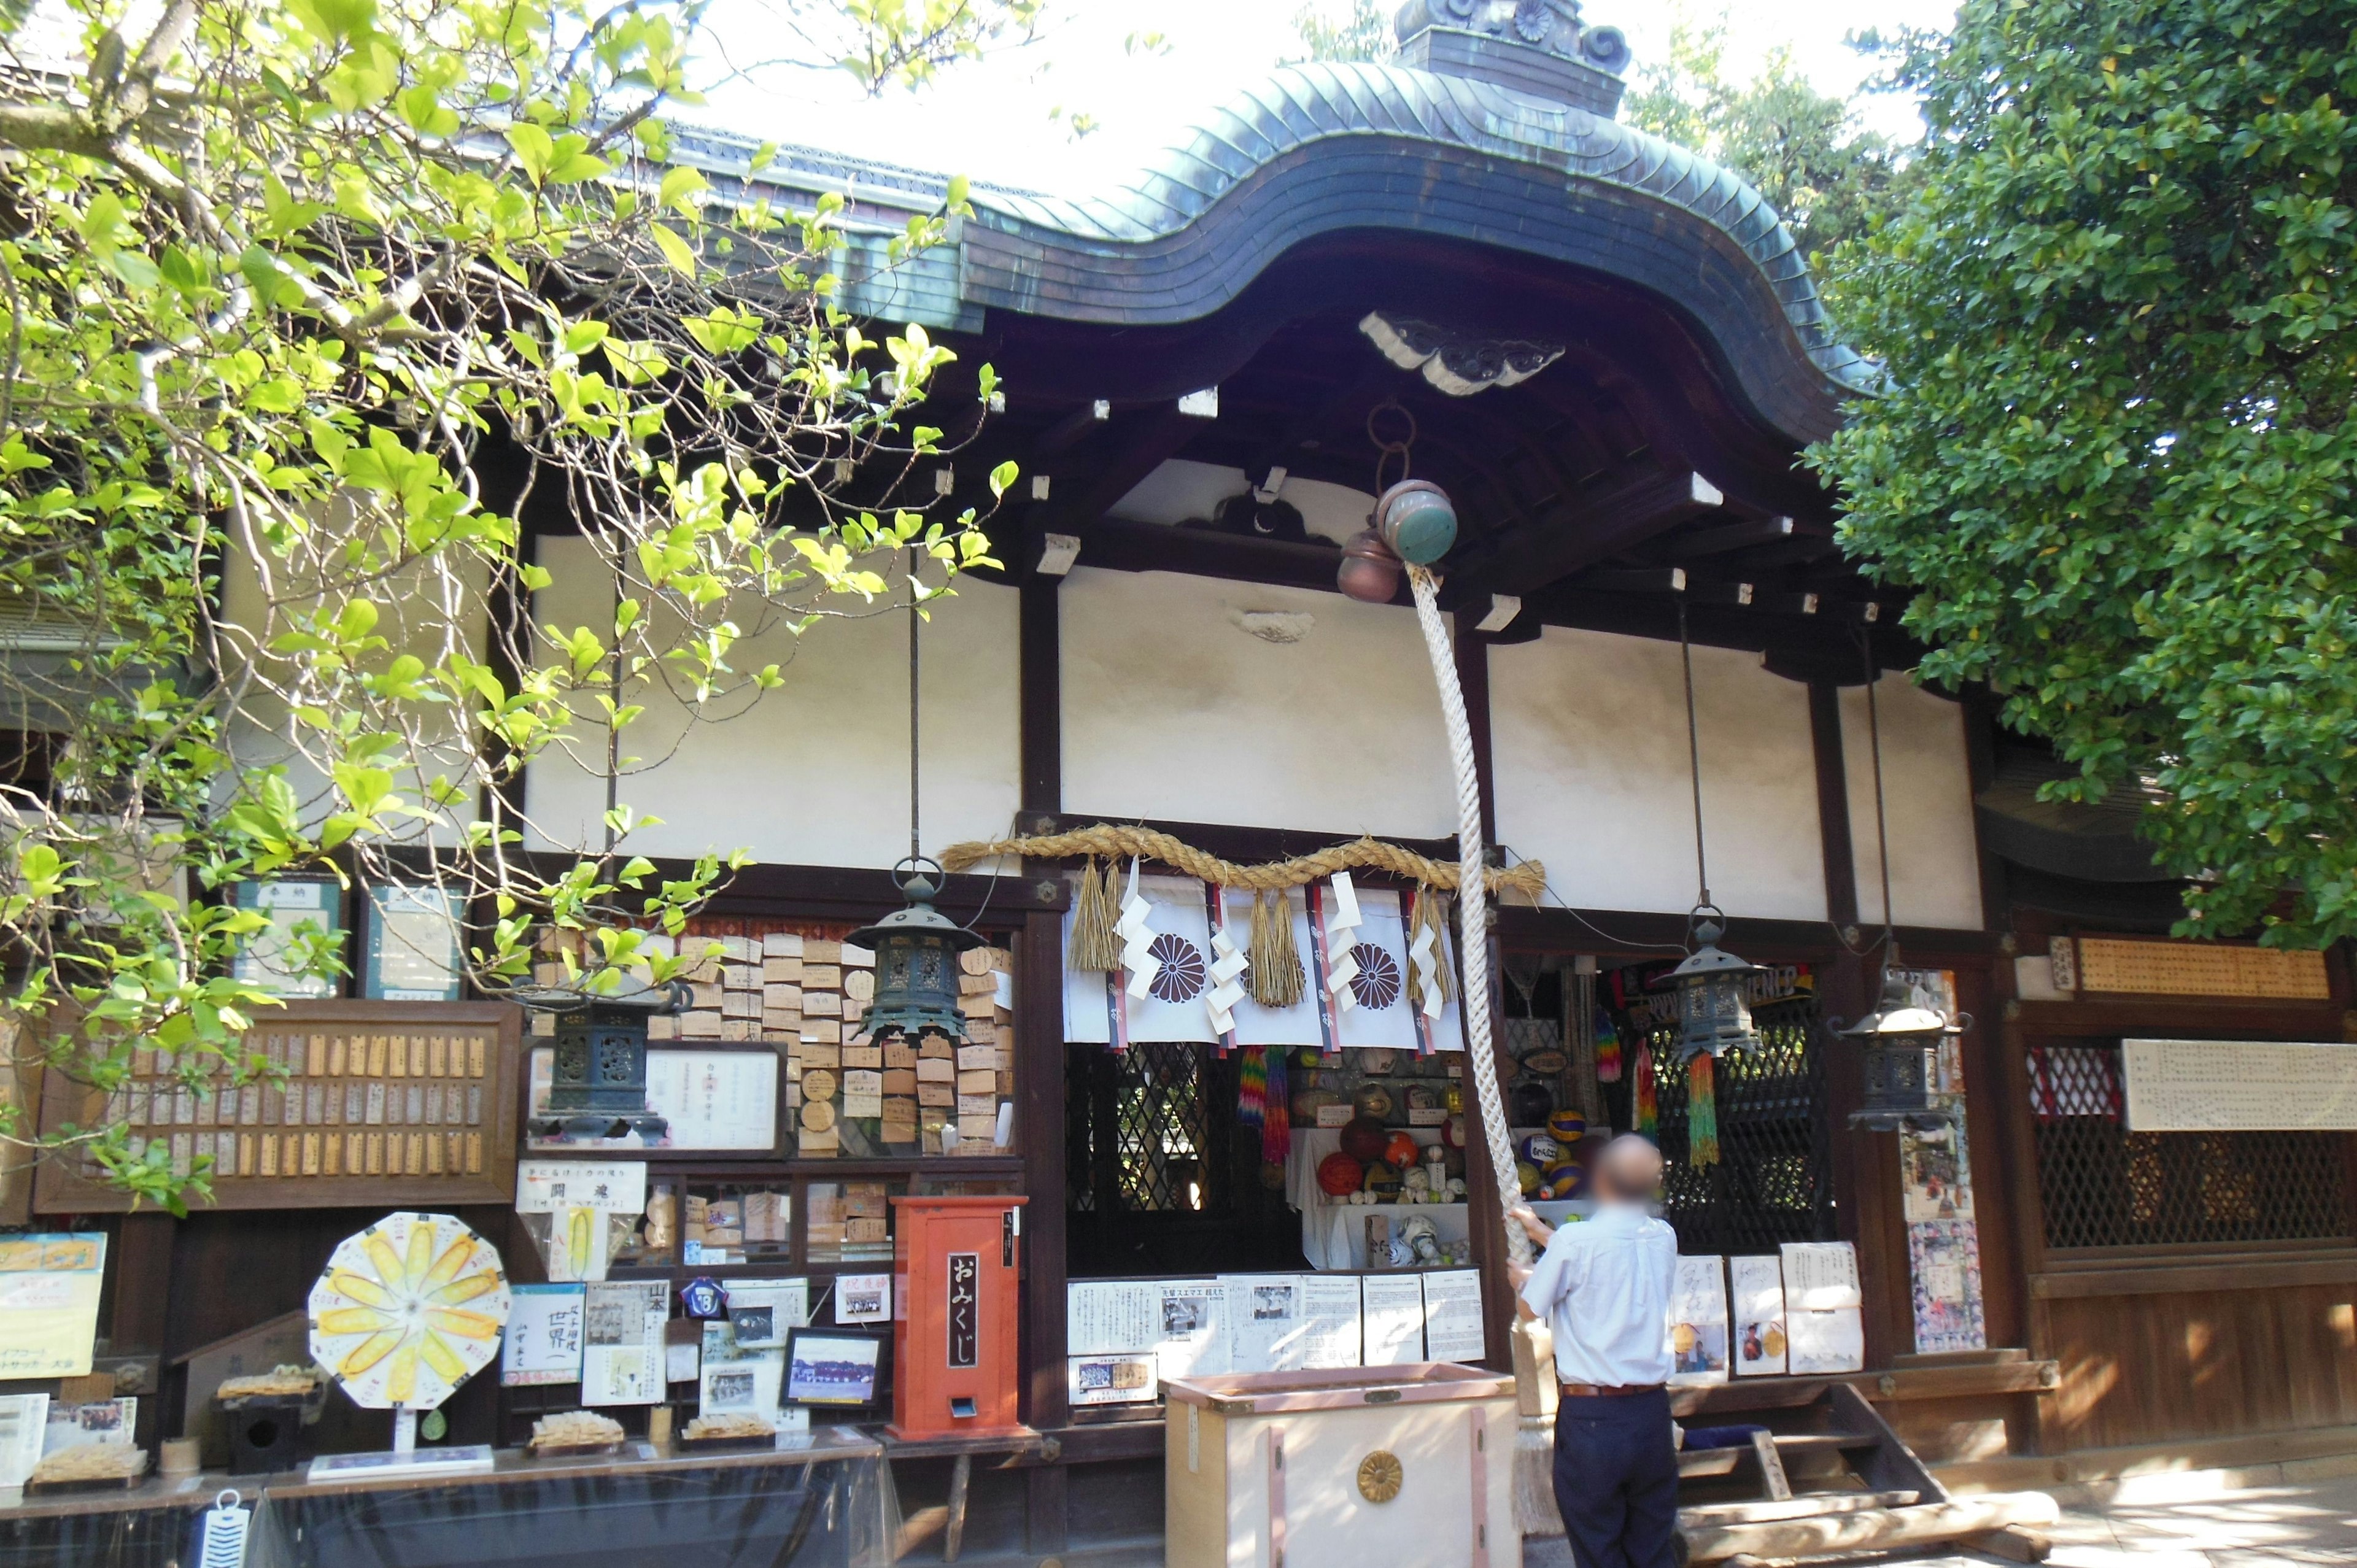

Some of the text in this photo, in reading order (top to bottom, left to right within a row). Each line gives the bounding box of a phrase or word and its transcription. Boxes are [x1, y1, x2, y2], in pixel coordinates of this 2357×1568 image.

[649, 1284, 665, 1311] 山本
[697, 1295, 711, 1311] 18
[952, 1259, 974, 1363] おみくじ
